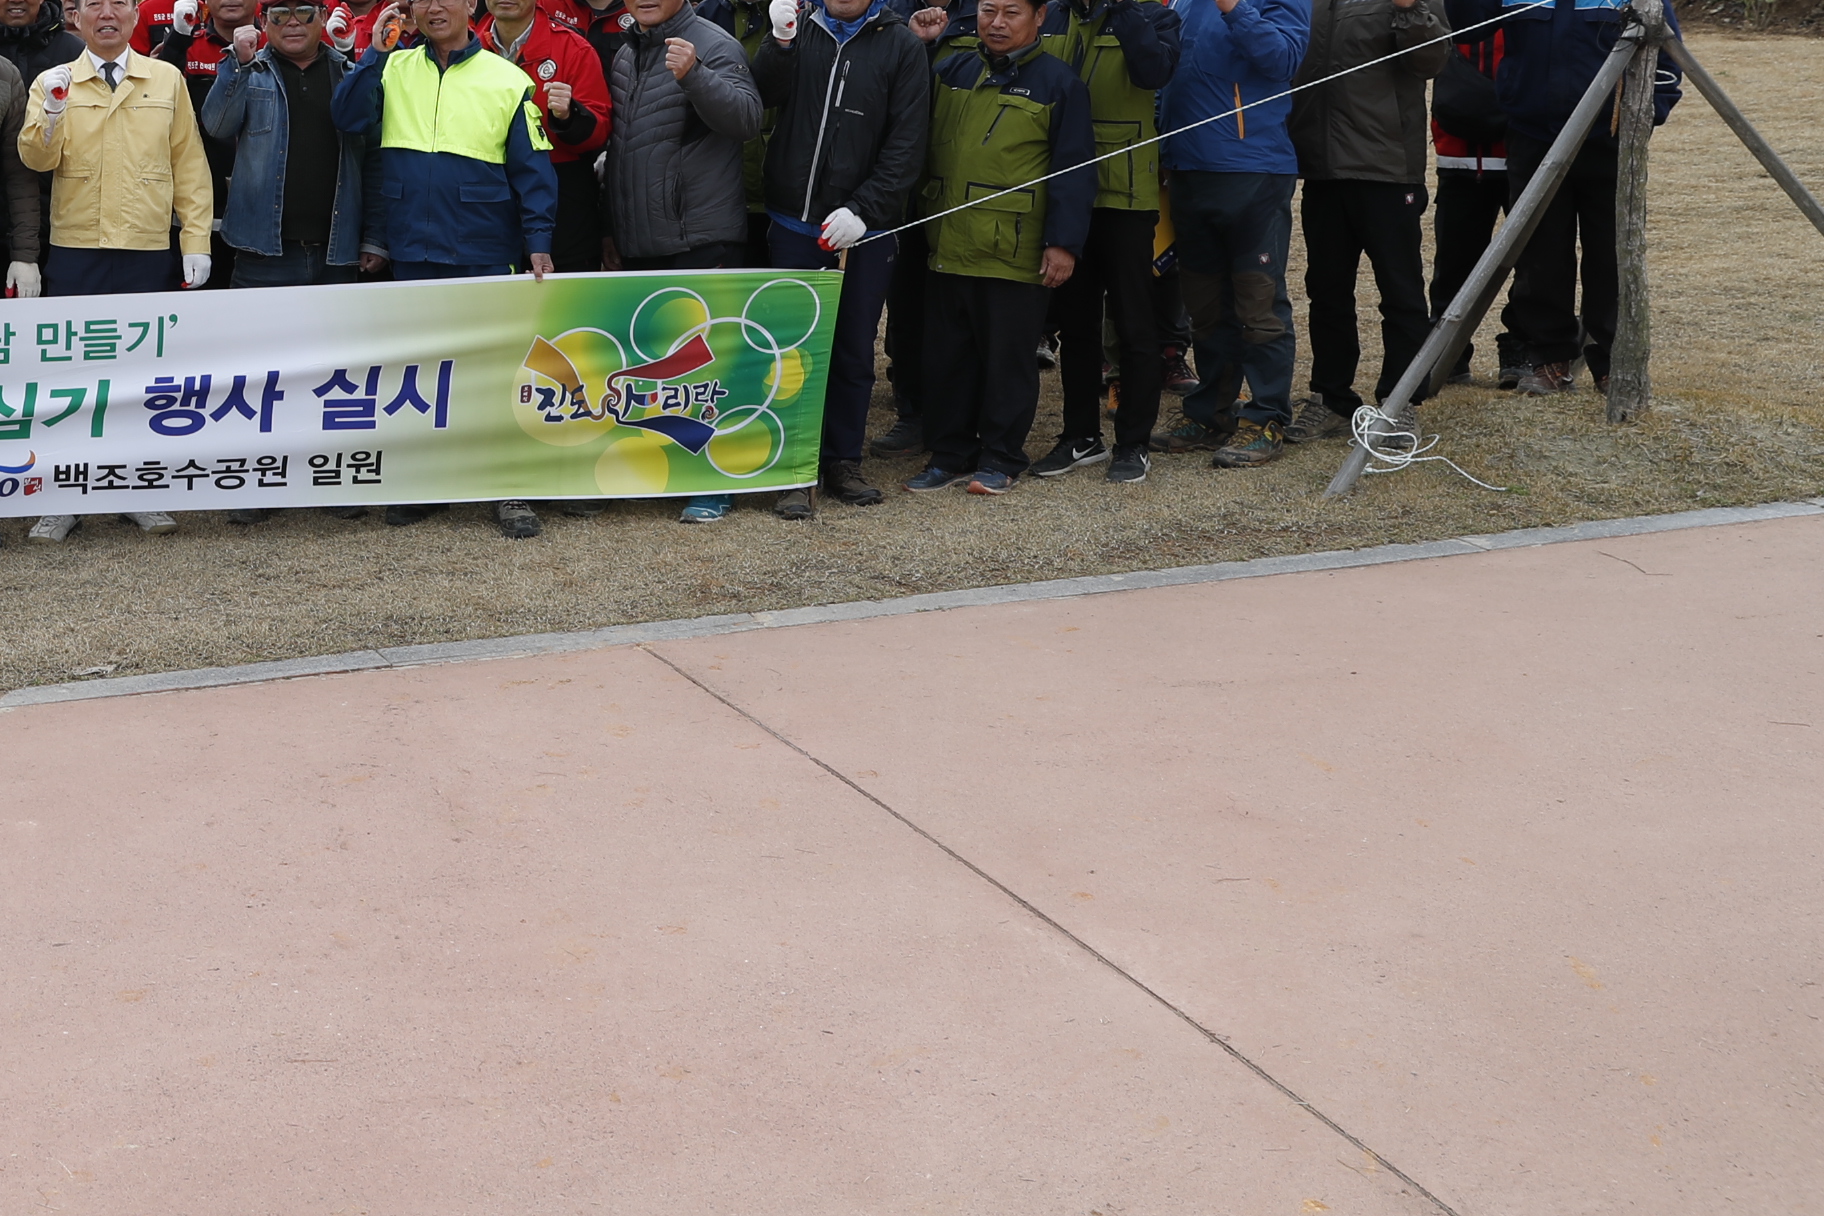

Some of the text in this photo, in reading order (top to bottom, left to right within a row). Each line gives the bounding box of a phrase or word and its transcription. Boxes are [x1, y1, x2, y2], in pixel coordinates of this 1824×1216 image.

[35, 314, 178, 364] 만들기’
[142, 370, 284, 438] 행사
[312, 359, 455, 431] 실시
[53, 454, 289, 495] 백조호수공원
[308, 449, 383, 487] 일원
